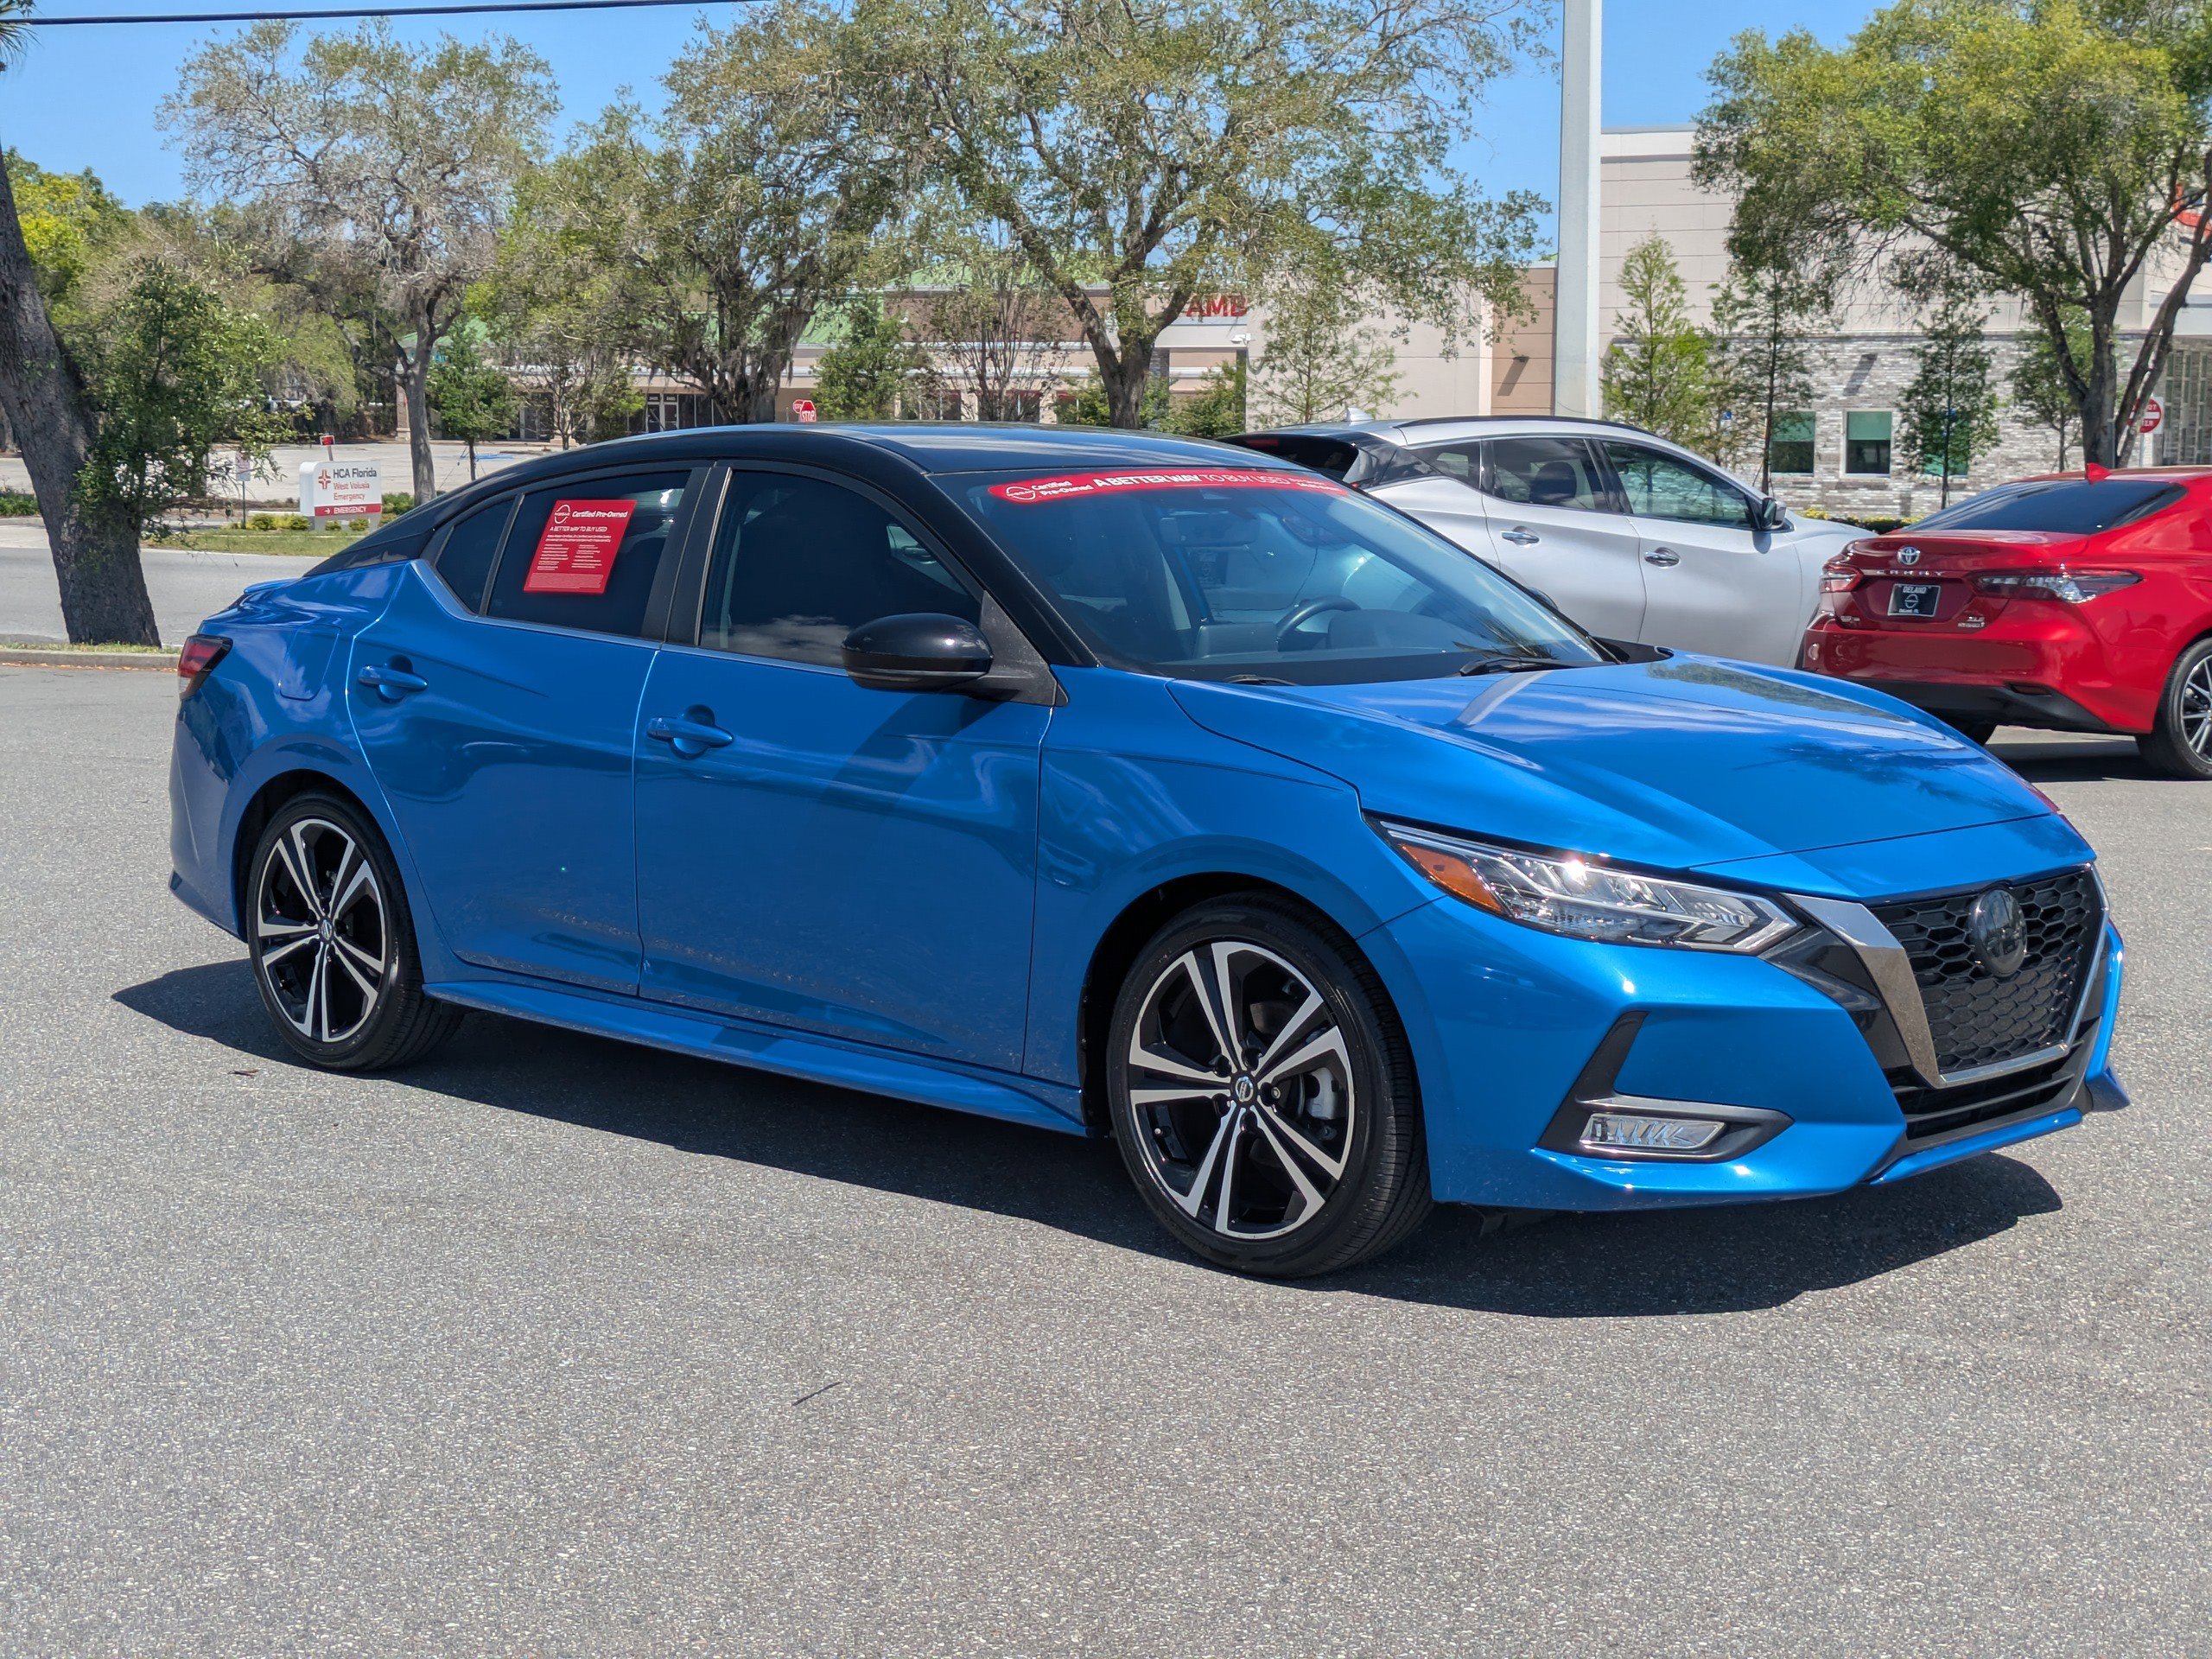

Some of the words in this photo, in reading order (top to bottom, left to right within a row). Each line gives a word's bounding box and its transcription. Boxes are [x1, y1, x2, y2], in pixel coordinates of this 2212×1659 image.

[333, 468, 351, 479] HCA
[352, 467, 377, 478] Florida
[1032, 480, 1072, 491] Certified
[1092, 478, 1112, 486] A
[1105, 475, 1164, 486] BETTER
[1039, 485, 1094, 496] Pre-Owned
[334, 493, 365, 501] Emergency
[571, 510, 596, 518] Certified
